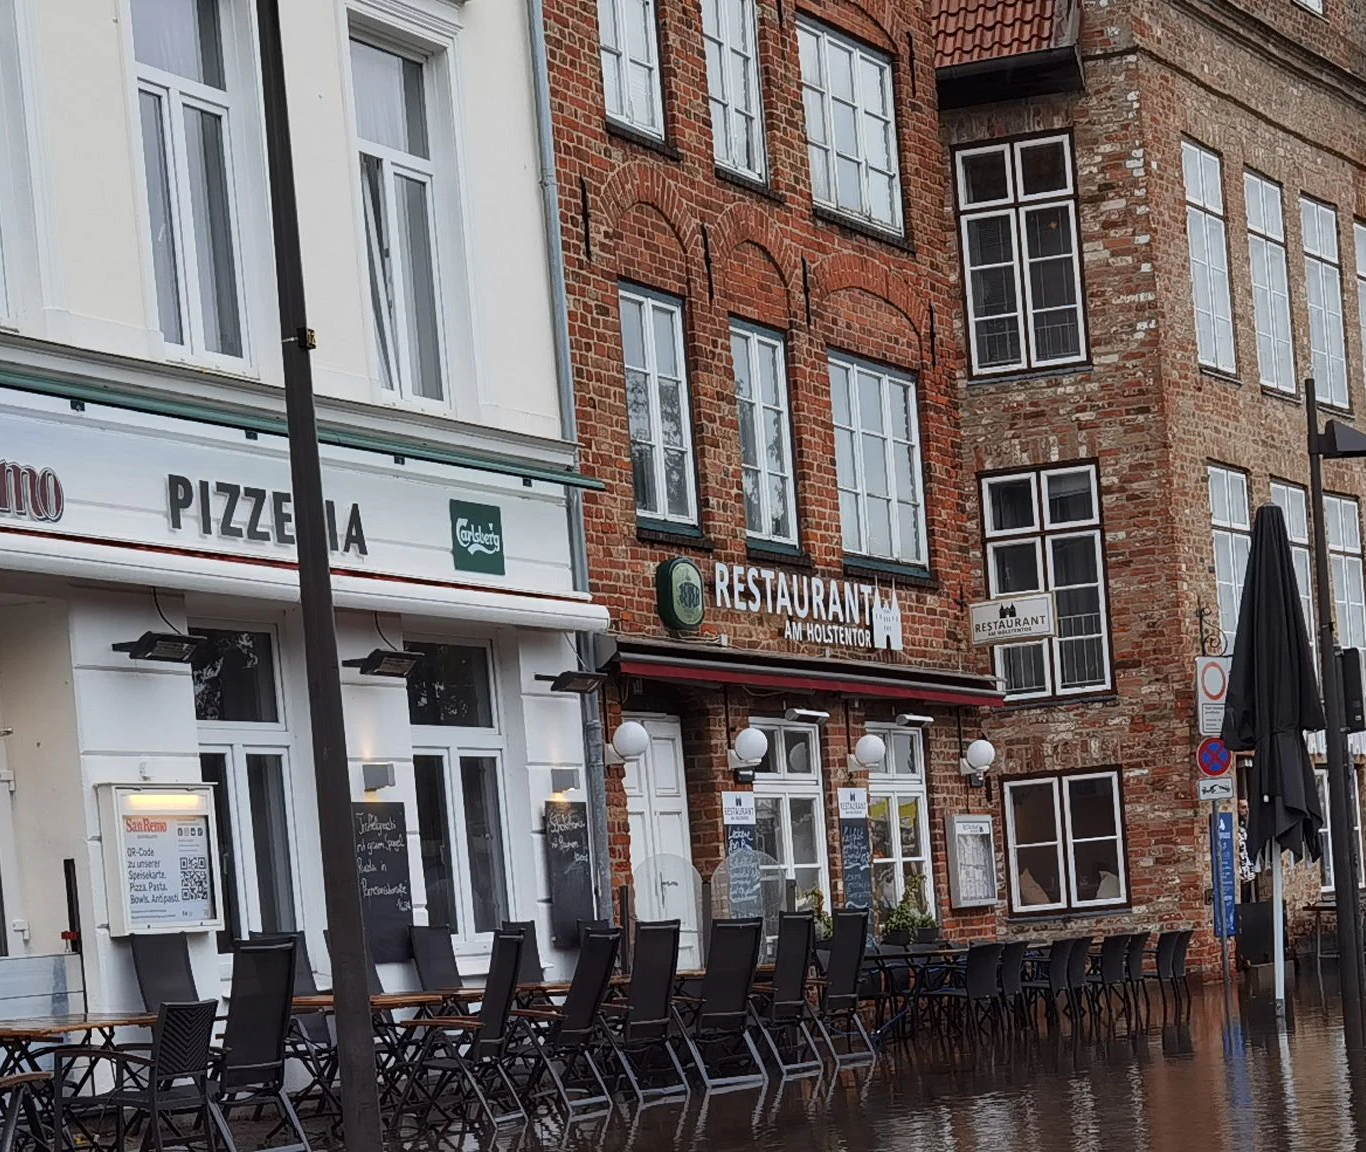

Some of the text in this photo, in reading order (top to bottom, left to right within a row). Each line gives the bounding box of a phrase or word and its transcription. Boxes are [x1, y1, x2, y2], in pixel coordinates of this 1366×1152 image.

[167, 474, 368, 556] PIZZEIA
[456, 517, 500, 555] Carlsberg
[715, 562, 875, 626] RESTAURANT
[785, 620, 872, 648] AM HOLSTENTOR
[975, 616, 1046, 633] RESTAURANT
[127, 847, 154, 857] QR-Code
[127, 860, 161, 868] zu unserer
